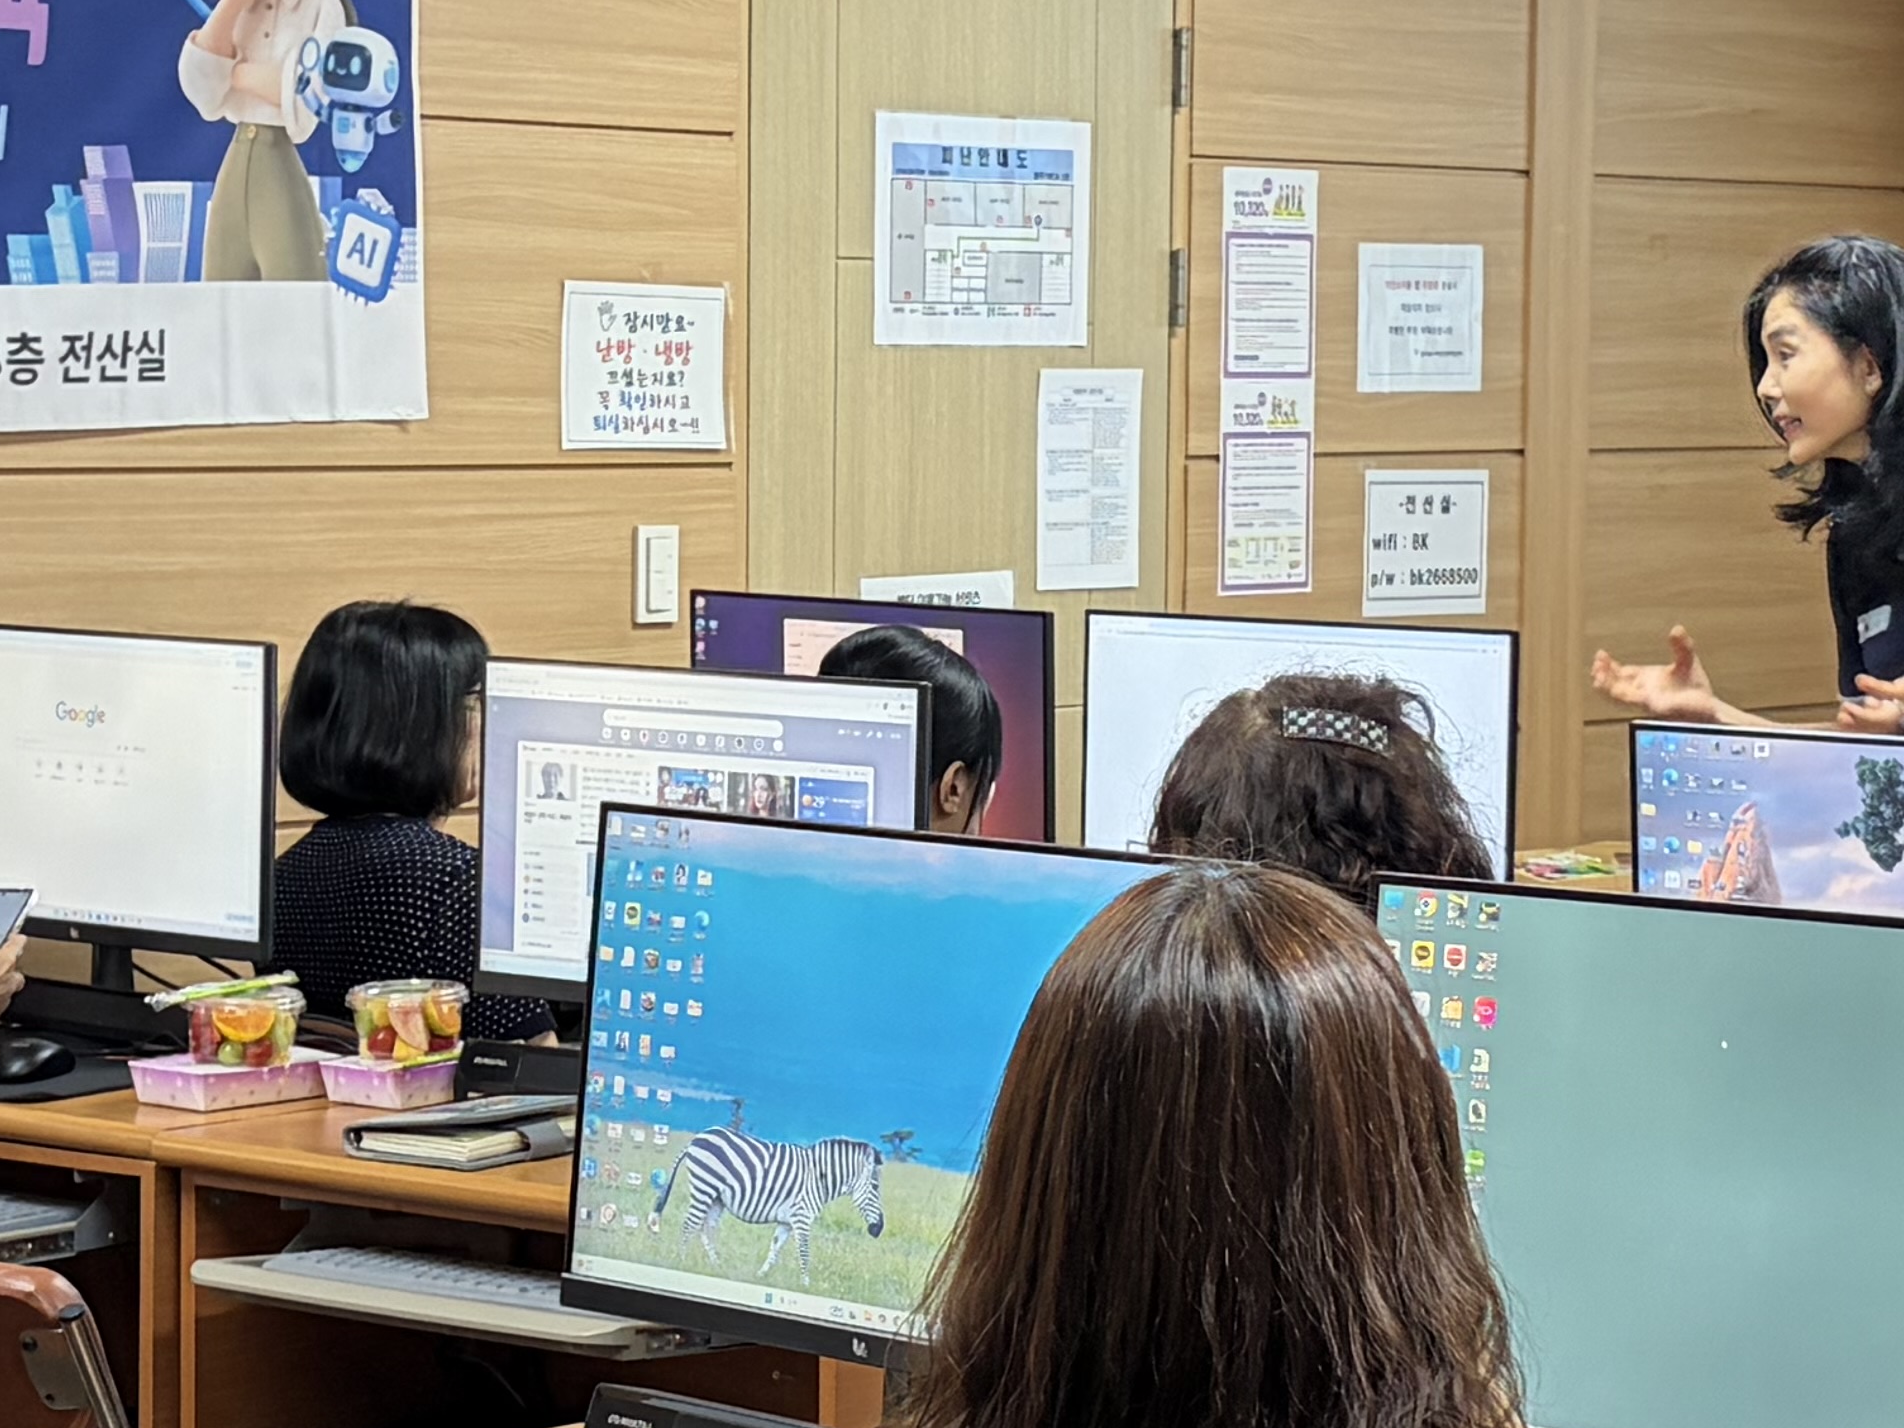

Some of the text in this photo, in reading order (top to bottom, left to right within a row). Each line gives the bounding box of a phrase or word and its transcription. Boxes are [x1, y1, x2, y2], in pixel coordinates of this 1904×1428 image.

[346, 233, 379, 269] AI
[57, 329, 170, 387] 전산실
[596, 338, 693, 366] 난방 냉방
[56, 701, 105, 727] Google
